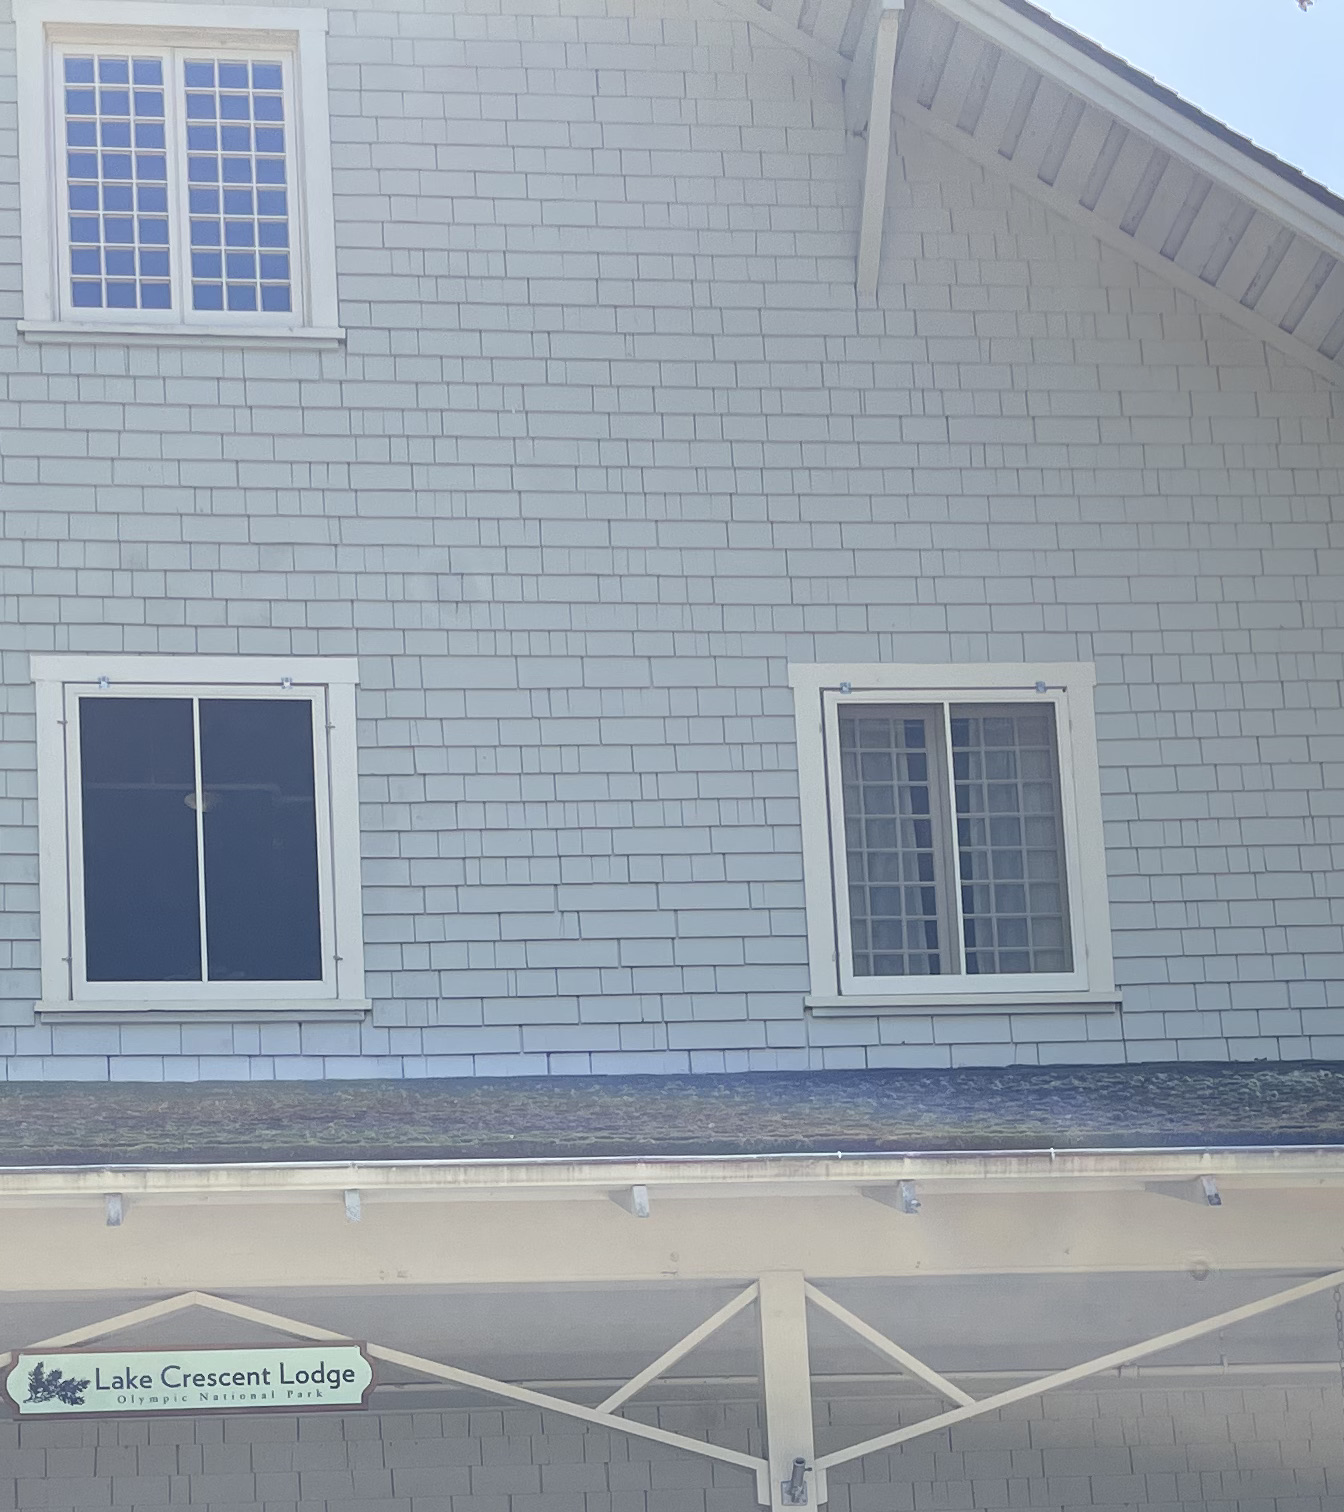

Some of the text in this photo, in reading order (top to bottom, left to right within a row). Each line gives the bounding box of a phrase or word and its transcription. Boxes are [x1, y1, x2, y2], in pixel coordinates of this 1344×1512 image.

[95, 1360, 355, 1391] Lake Crescent Lodge
[117, 1389, 323, 1406] Olympic National Park
